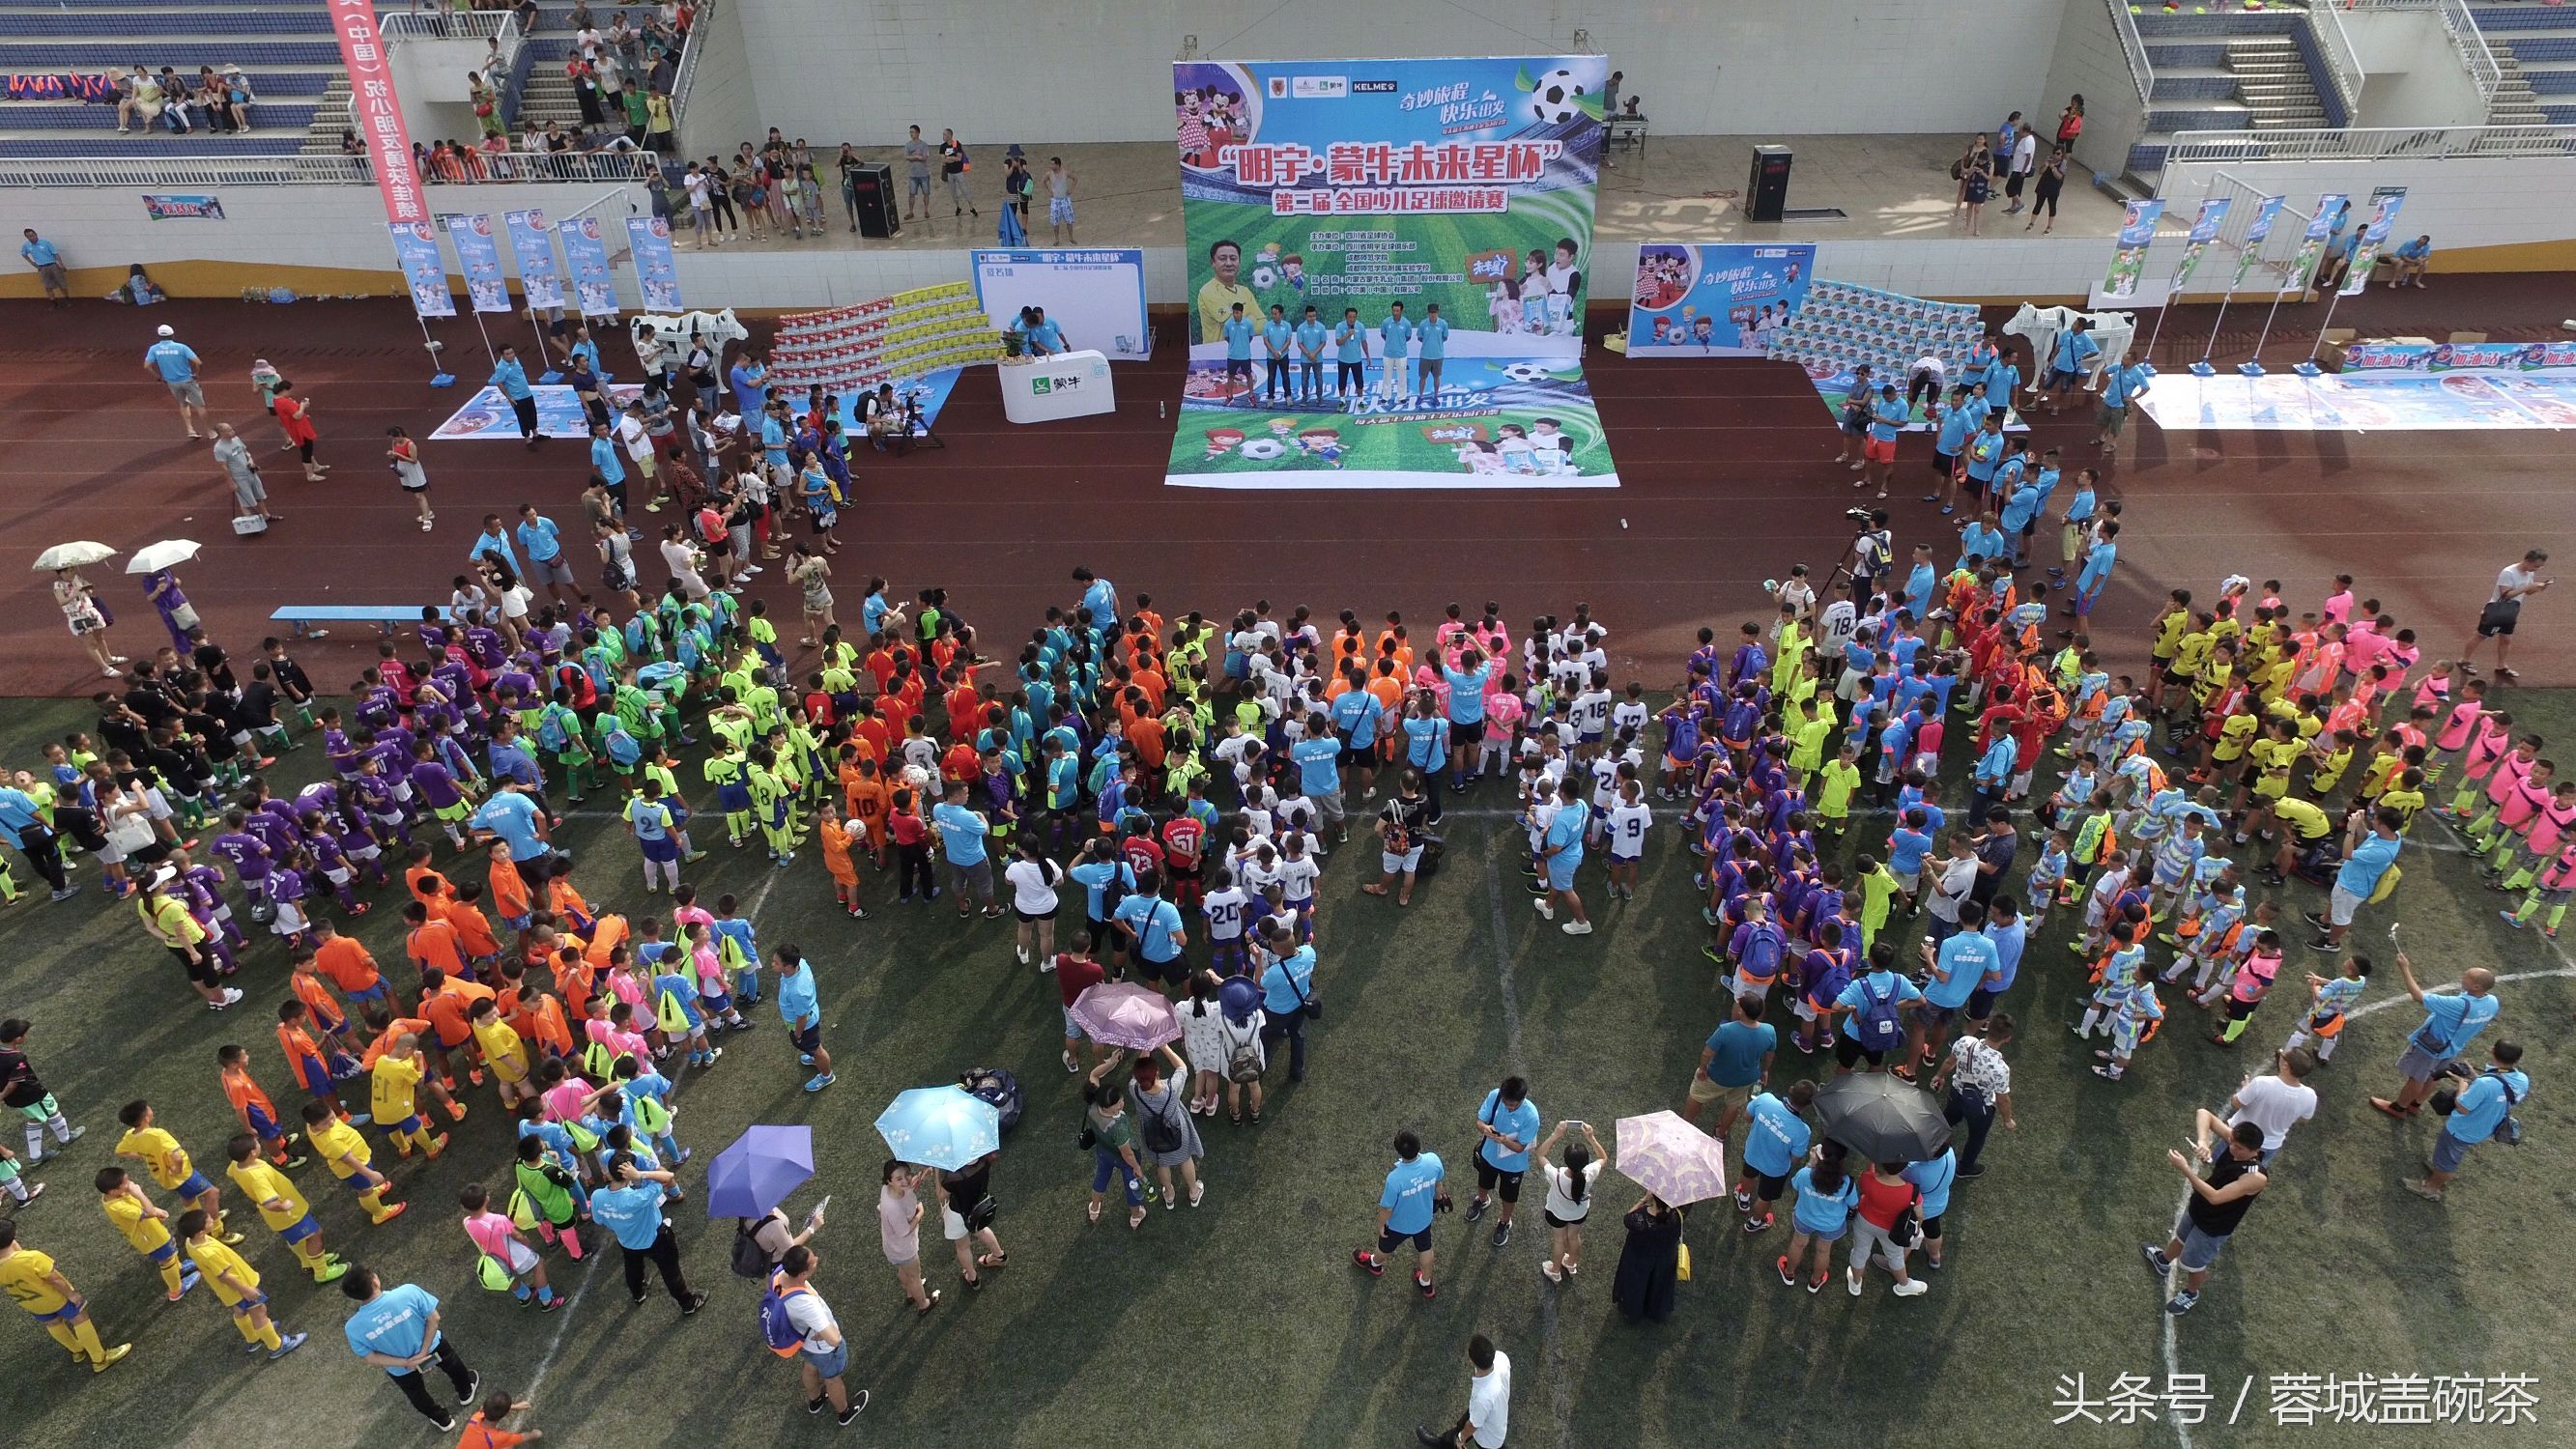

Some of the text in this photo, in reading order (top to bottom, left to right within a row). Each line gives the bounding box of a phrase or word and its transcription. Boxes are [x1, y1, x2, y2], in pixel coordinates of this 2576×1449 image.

[1400, 82, 1469, 110] 奇妙旅程
[1440, 99, 1505, 124] 快乐出发
[1221, 143, 1561, 184] “明宇·蒙牛未来星杯”
[1335, 189, 1505, 211] 全国少儿足球邀请赛
[2362, 355, 2409, 367] 加油站
[2451, 353, 2500, 366] 加油站
[1053, 376, 1081, 390] 蒙牛
[1833, 617, 1851, 636] 18
[474, 639, 485, 654] 6
[1174, 663, 1188, 679] 10
[754, 698, 772, 719] 13
[1500, 705, 1509, 722] 7
[1589, 701, 1607, 718] 18
[758, 787, 770, 806] 8
[854, 797, 876, 816] 10
[337, 817, 350, 836] 5
[640, 815, 655, 833] 2
[1627, 817, 1641, 838] 9
[256, 828, 267, 843] 7
[1172, 834, 1193, 852] 51
[229, 847, 244, 864] 5
[1130, 853, 1153, 873] 23
[1212, 902, 1239, 924] 20
